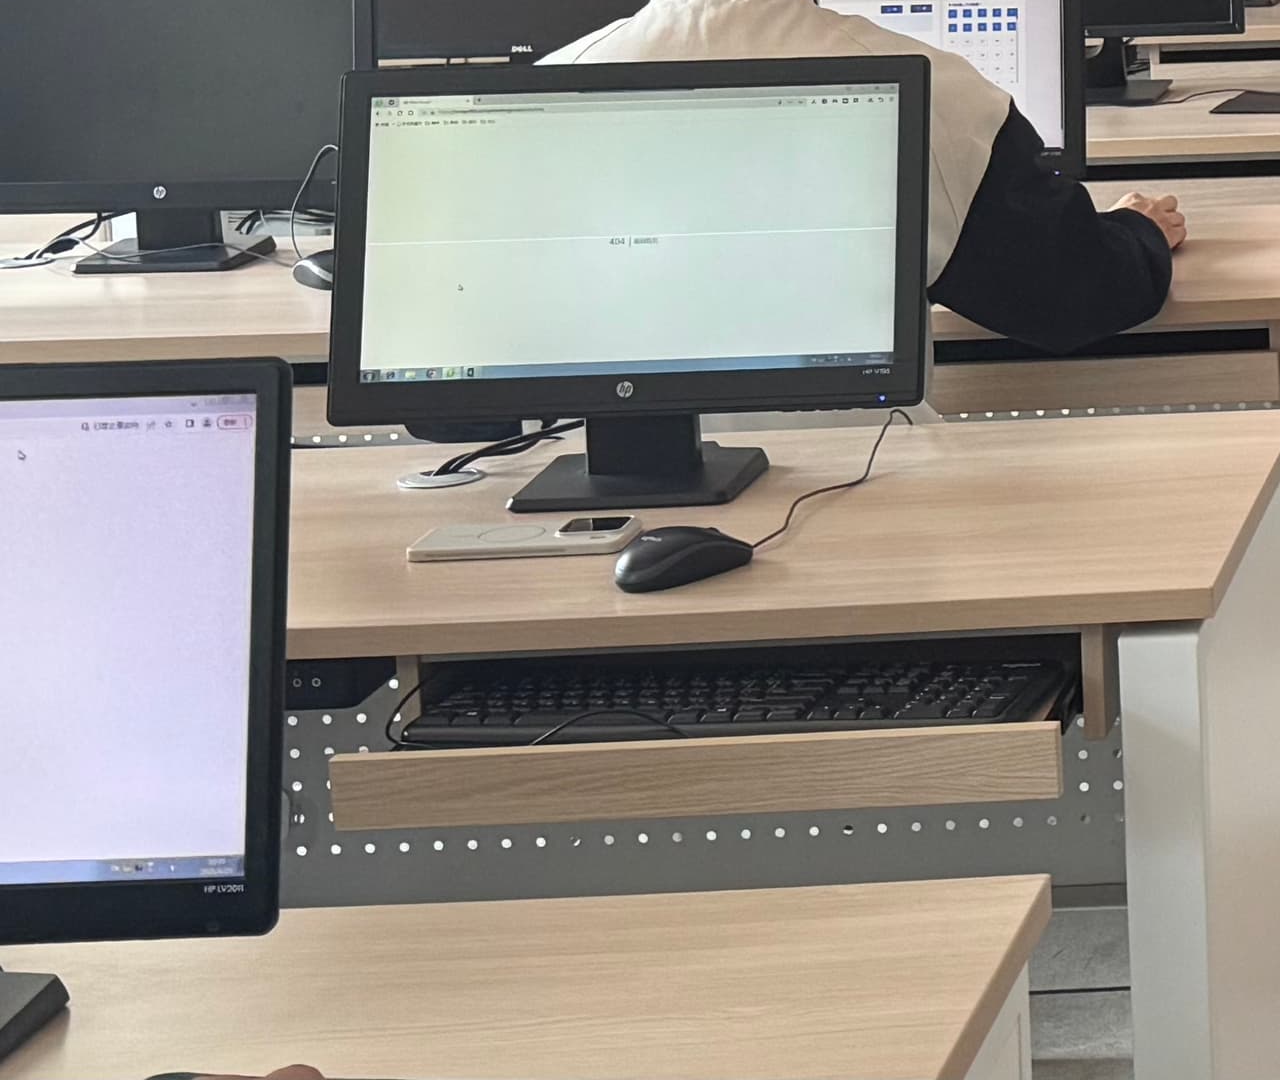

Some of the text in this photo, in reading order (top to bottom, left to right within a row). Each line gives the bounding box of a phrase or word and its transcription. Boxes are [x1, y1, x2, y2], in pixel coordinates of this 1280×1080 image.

[511, 44, 533, 53] DELL
[616, 381, 634, 398] hp
[203, 885, 217, 894] HP
